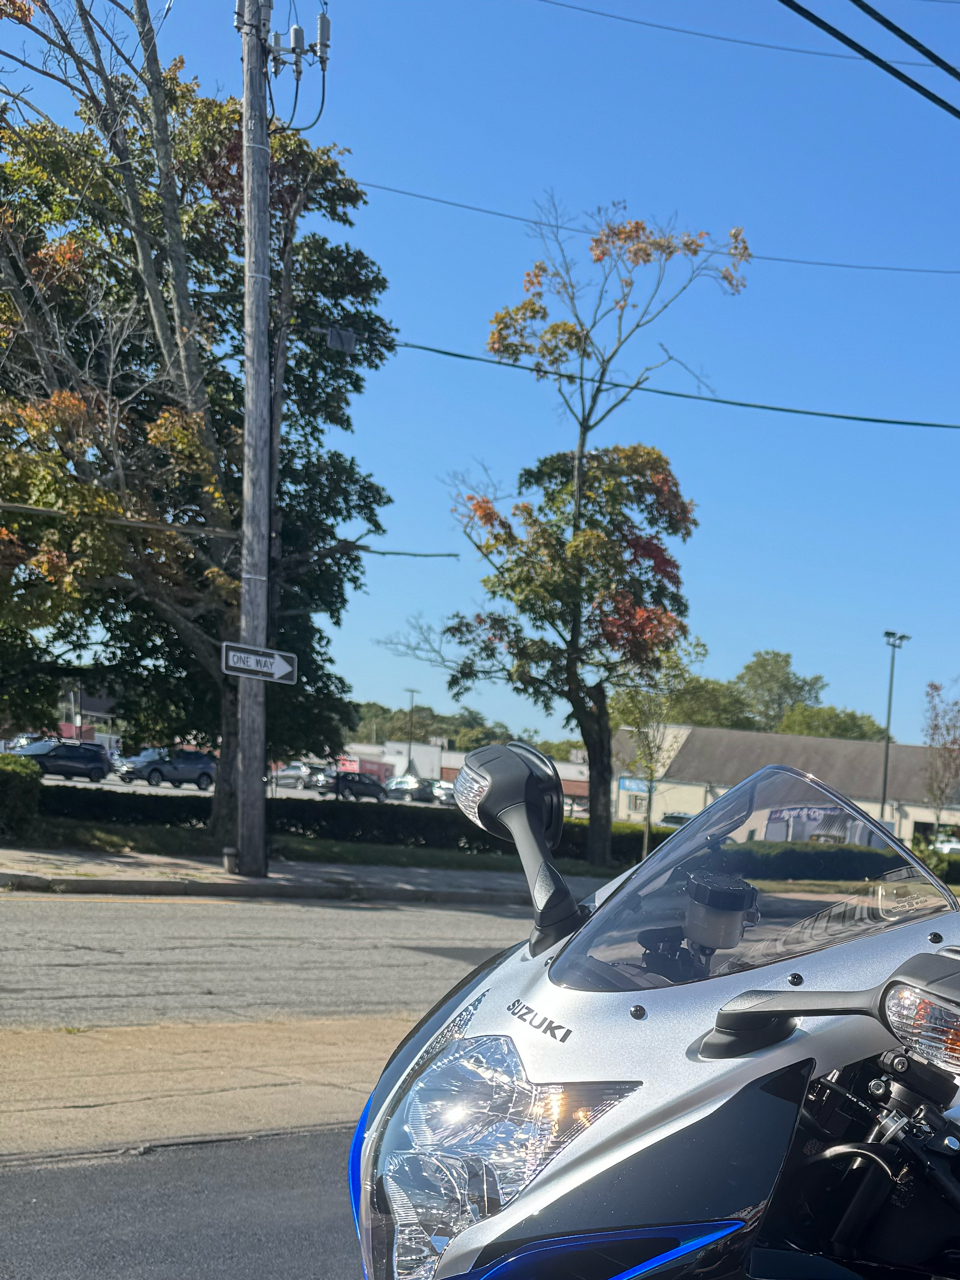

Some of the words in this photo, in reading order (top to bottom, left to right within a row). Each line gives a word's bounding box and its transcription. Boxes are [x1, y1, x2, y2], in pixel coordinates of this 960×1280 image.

[232, 653, 252, 668] ONE
[255, 657, 275, 672] WAY
[506, 998, 573, 1044] SUZUKI
